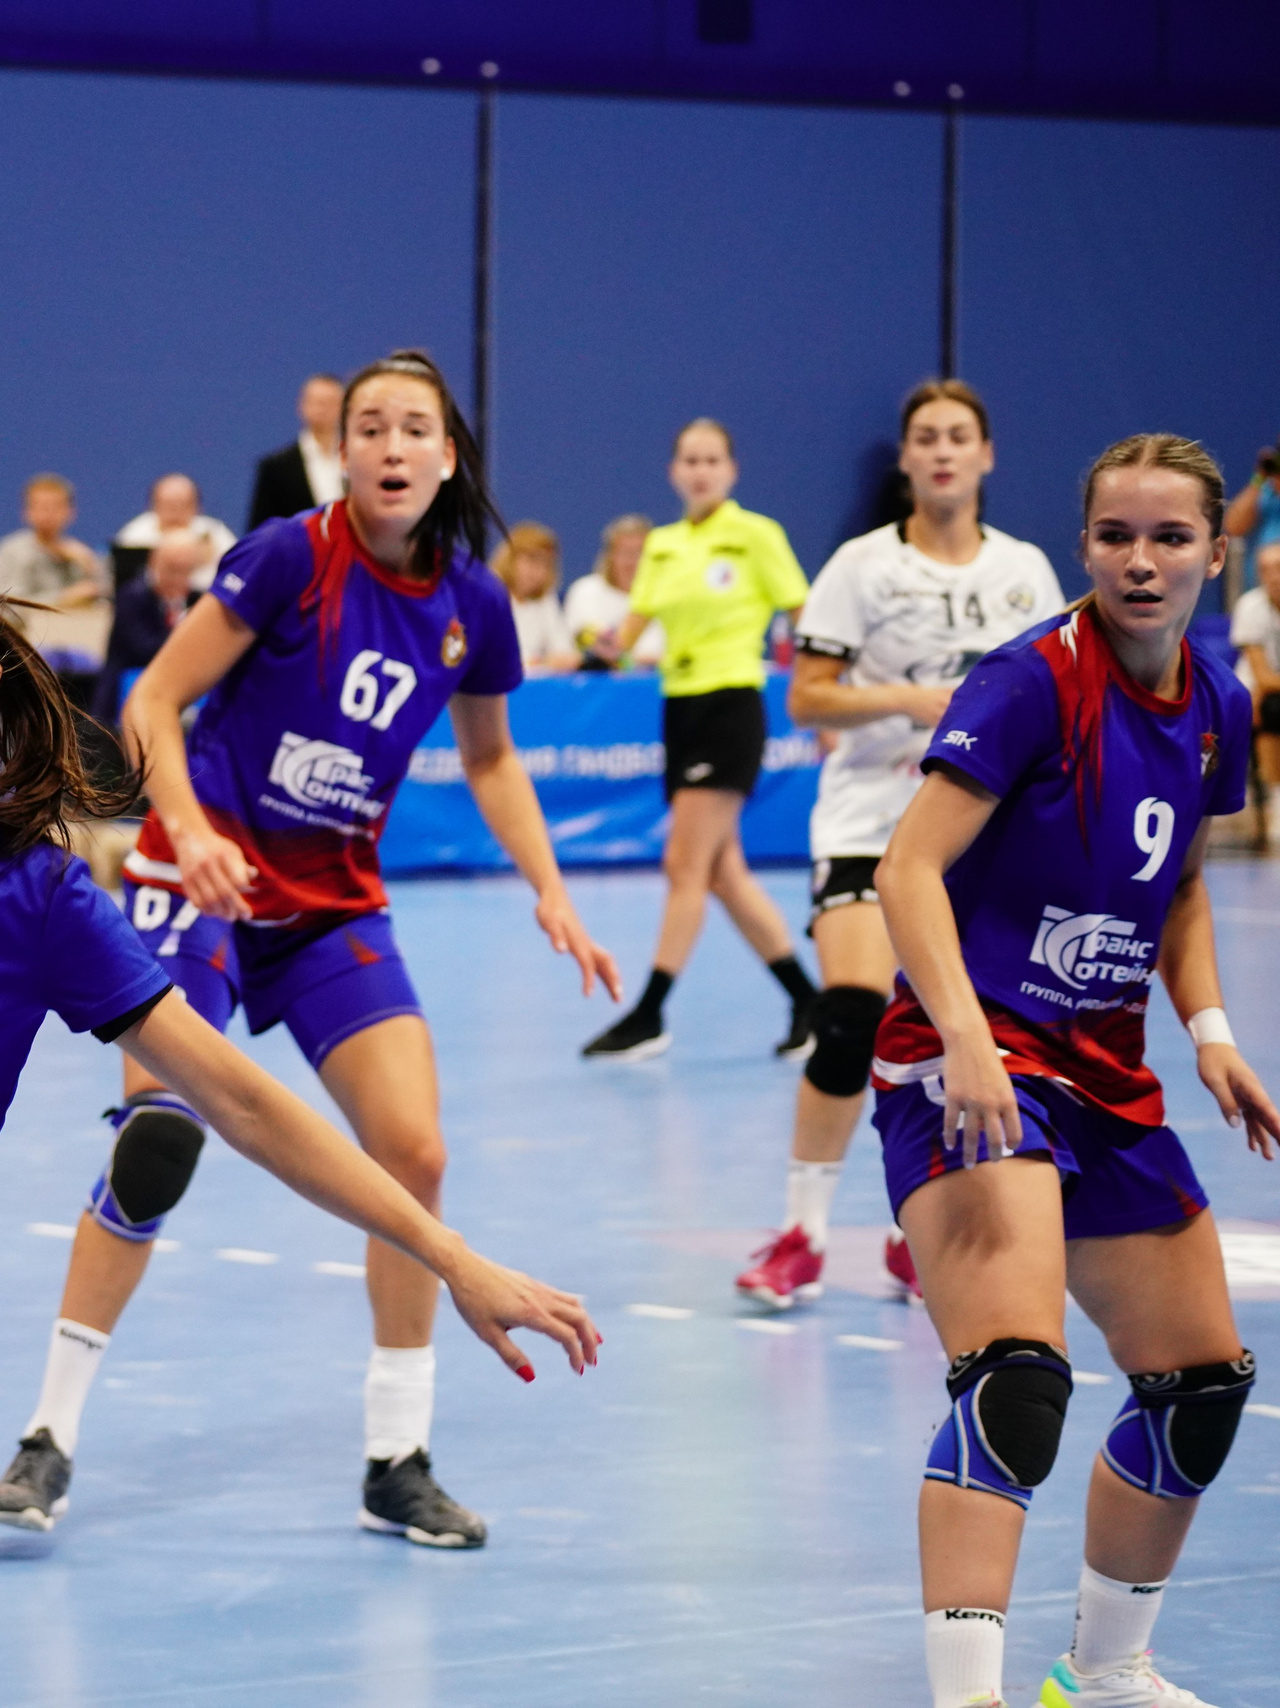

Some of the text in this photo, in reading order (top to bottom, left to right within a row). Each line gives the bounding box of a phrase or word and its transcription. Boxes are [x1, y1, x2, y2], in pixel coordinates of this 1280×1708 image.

[940, 591, 986, 629] 14
[339, 648, 417, 732] 67
[1130, 796, 1175, 882] 9
[1020, 981, 1073, 1009] ГРУППА
